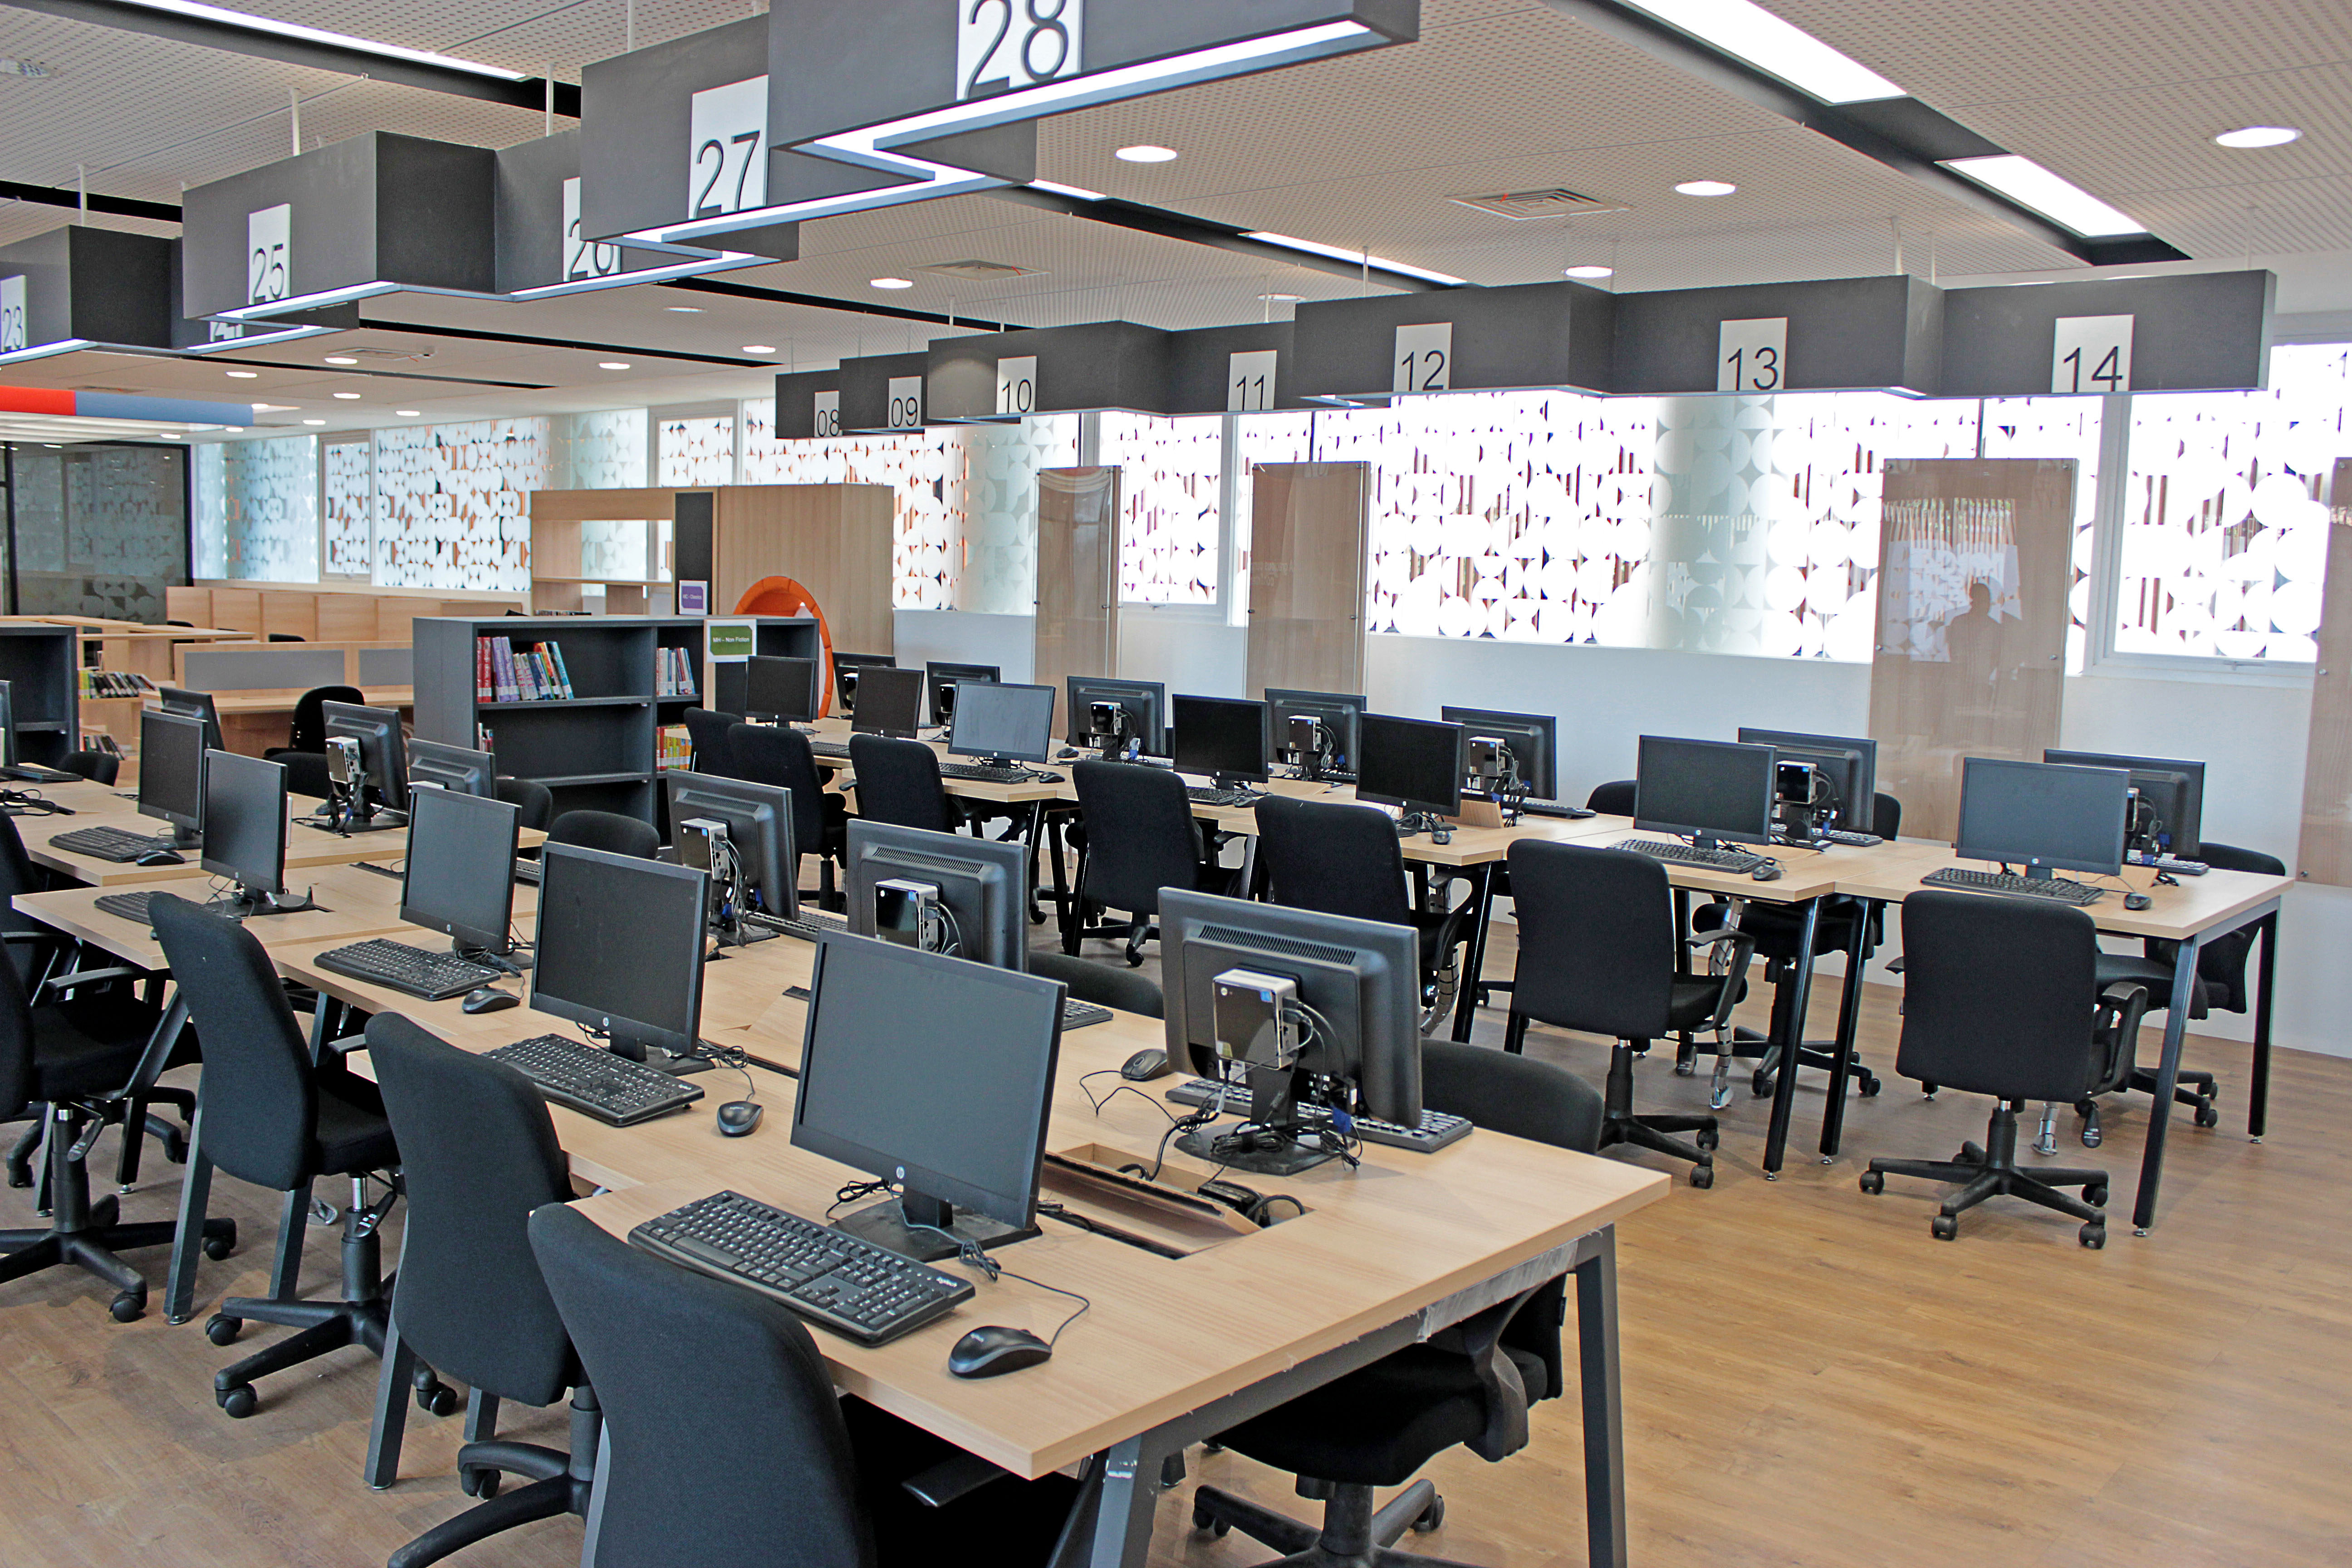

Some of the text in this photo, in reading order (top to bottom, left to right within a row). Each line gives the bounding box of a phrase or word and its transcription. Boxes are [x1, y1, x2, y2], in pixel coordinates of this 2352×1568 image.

[967, 0, 1068, 98] 28
[696, 132, 760, 218] 27
[253, 244, 284, 304] 25
[1, 306, 24, 350] 23
[1401, 350, 1445, 391] 12
[1727, 348, 1778, 391] 13
[2063, 346, 2123, 392] 14
[892, 397, 918, 427] 09
[1002, 379, 1032, 413] 10
[1236, 375, 1264, 411] 11
[818, 409, 839, 437] 08
